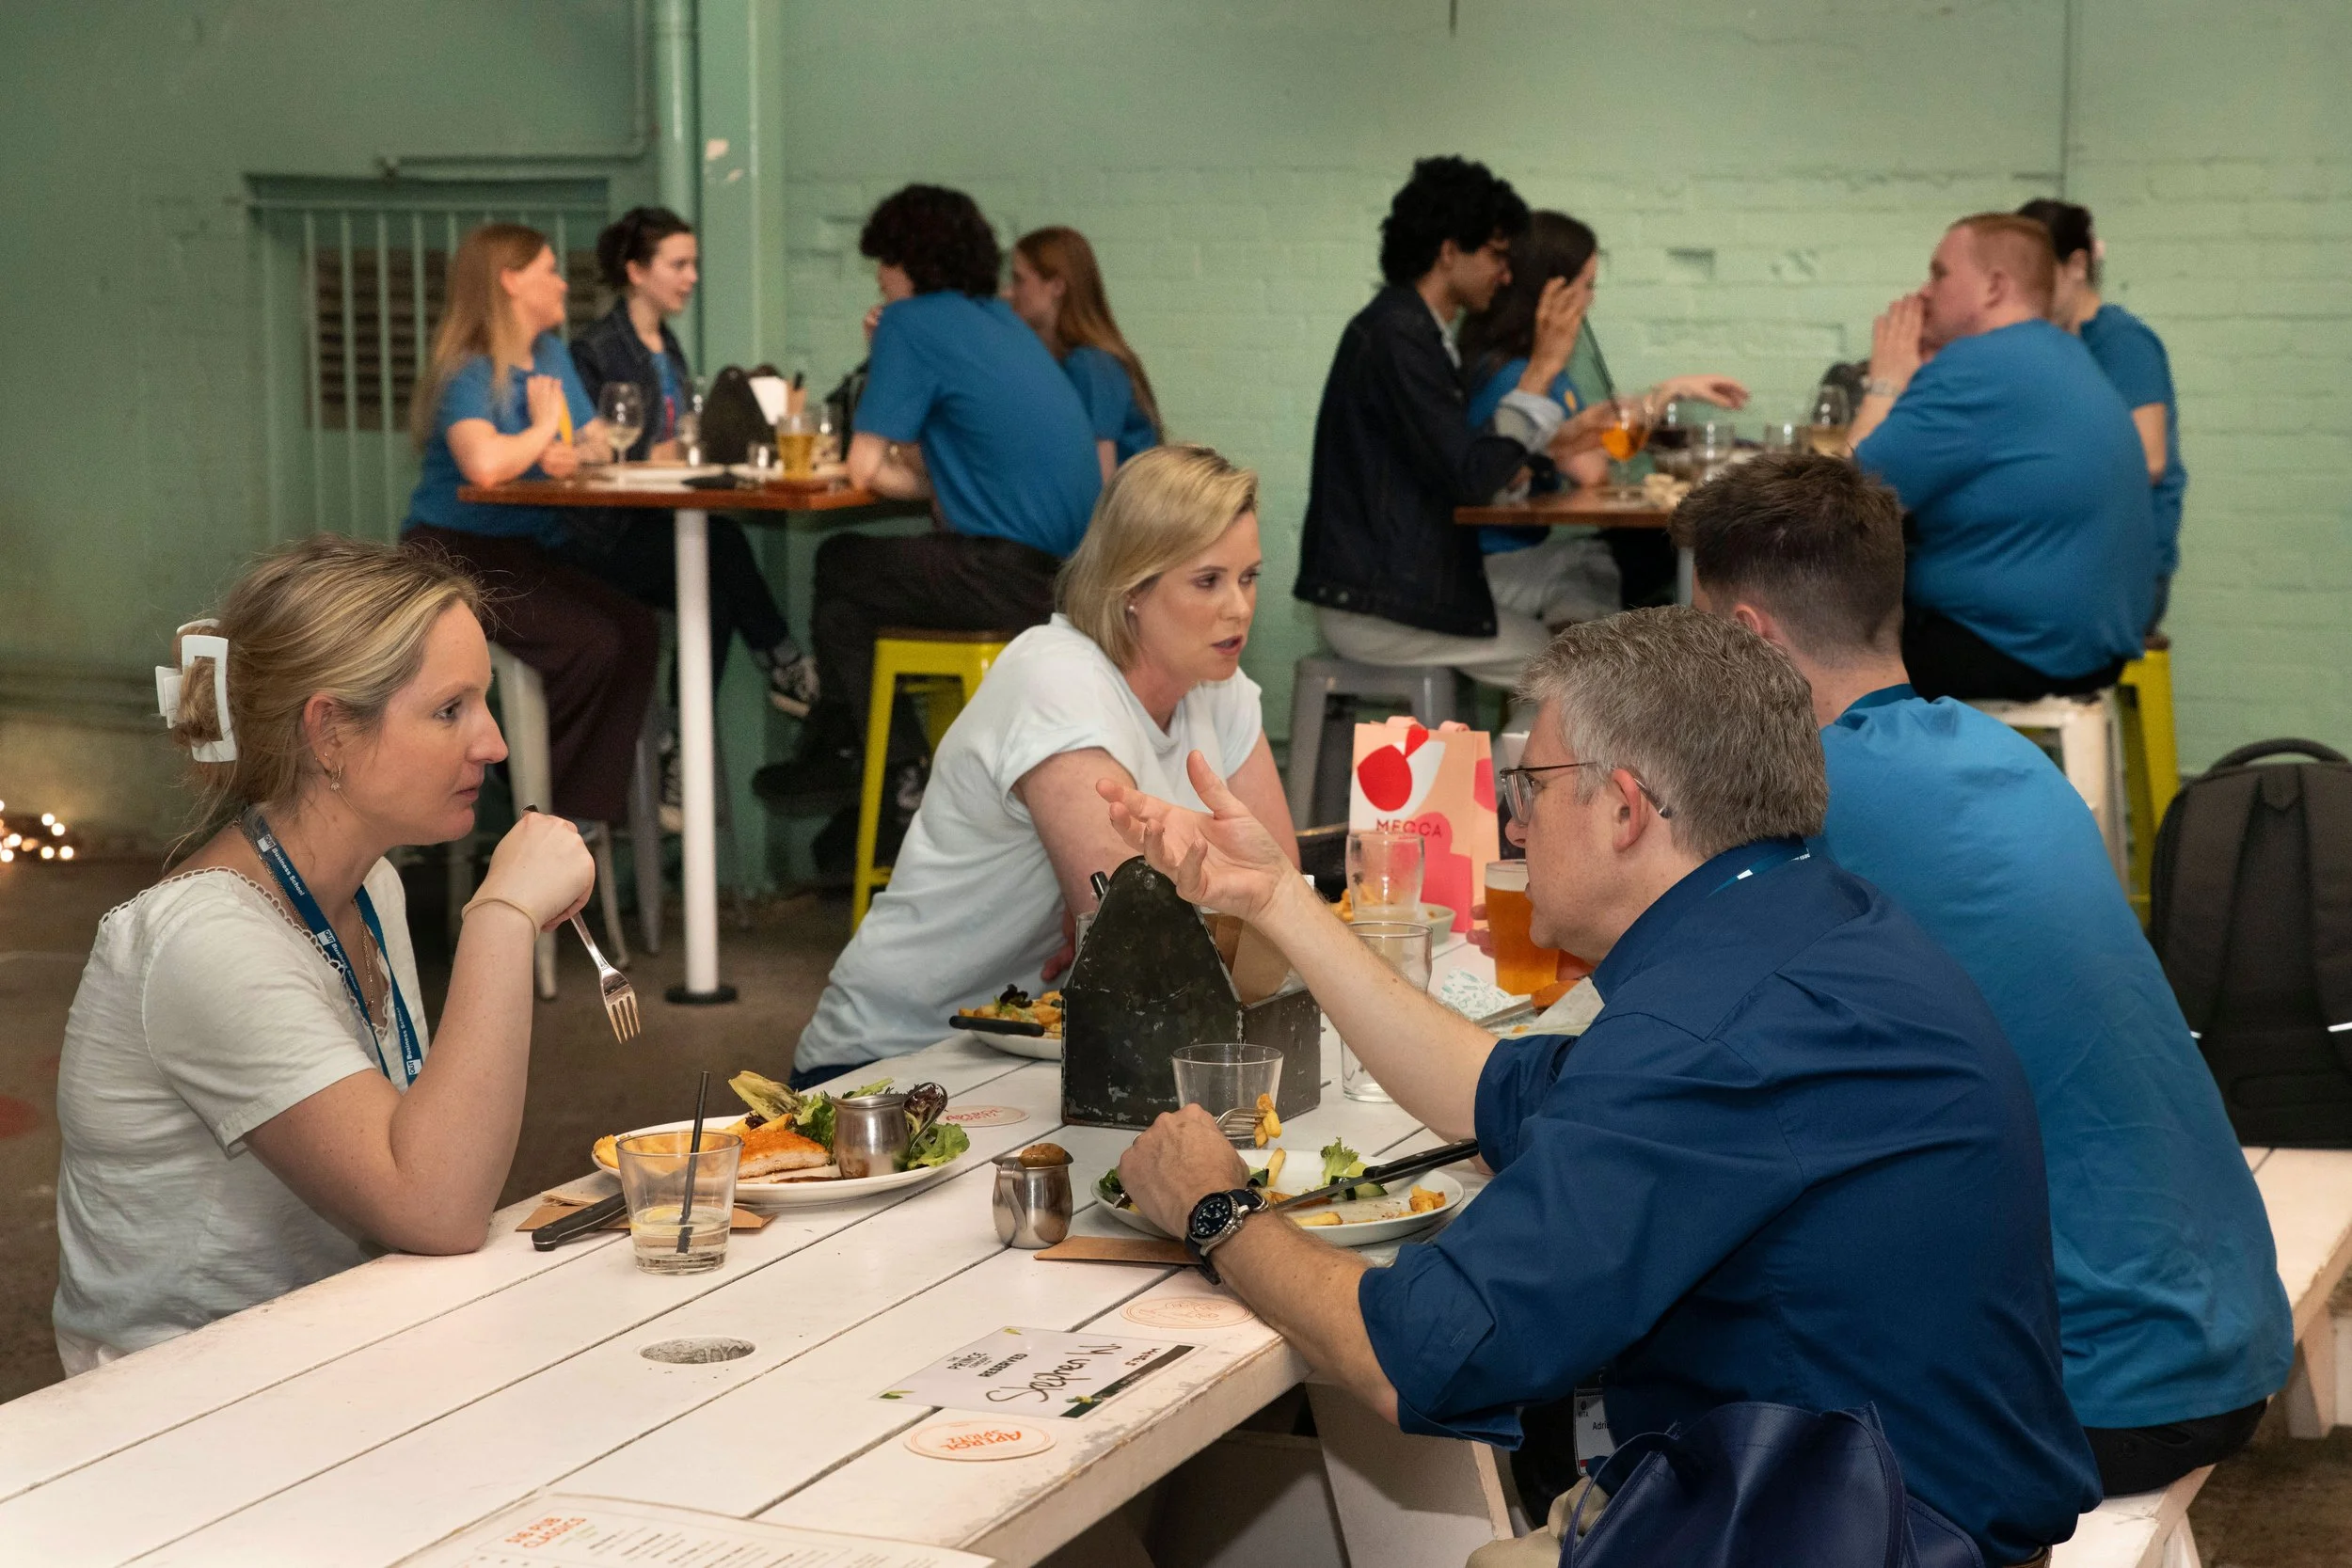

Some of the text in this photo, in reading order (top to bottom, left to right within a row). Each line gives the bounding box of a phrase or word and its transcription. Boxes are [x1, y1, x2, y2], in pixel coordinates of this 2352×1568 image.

[1376, 819, 1442, 838] MECCA
[272, 847, 292, 876] Business
[290, 876, 306, 896] School
[396, 1006, 406, 1029] School
[403, 1030, 413, 1060] Business
[946, 1352, 989, 1370] PRINCE
[977, 1353, 1028, 1377] RESERVED
[985, 1358, 1092, 1403] Stephen
[940, 1430, 1023, 1451] APEROL
